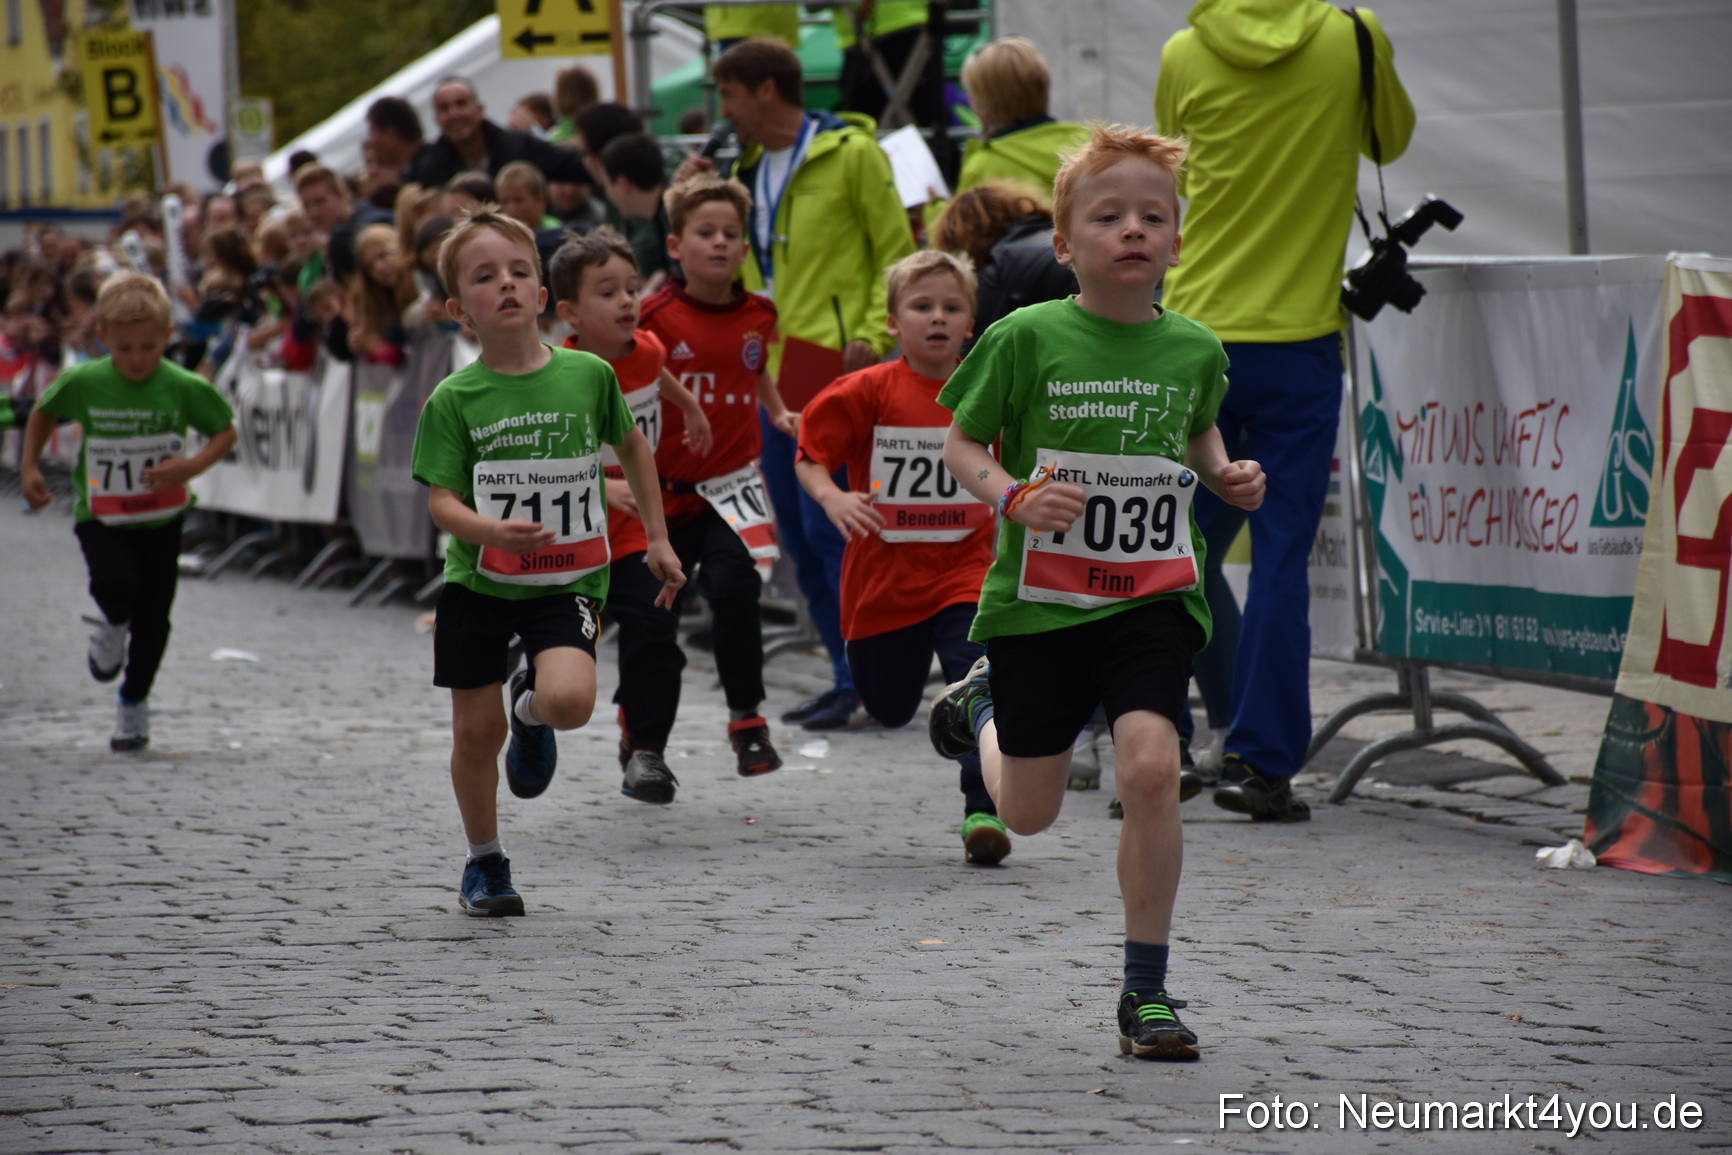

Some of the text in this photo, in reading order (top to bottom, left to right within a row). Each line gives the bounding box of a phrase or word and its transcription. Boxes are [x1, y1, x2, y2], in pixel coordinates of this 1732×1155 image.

[102, 66, 143, 122] B
[1047, 376, 1160, 397] Neumarkter
[1049, 401, 1139, 423] Stadtlauf
[470, 411, 560, 442] Neumarkter
[875, 438, 914, 450] PARTL
[477, 470, 588, 486] PARTL Neumarkt
[883, 457, 963, 498] 720
[1035, 465, 1173, 488] PARTL Neumarkt
[490, 486, 592, 536] 7111
[896, 510, 966, 527] Benedikt
[1052, 494, 1177, 554] 039
[520, 551, 575, 571] Simon
[1087, 567, 1135, 592] Finn
